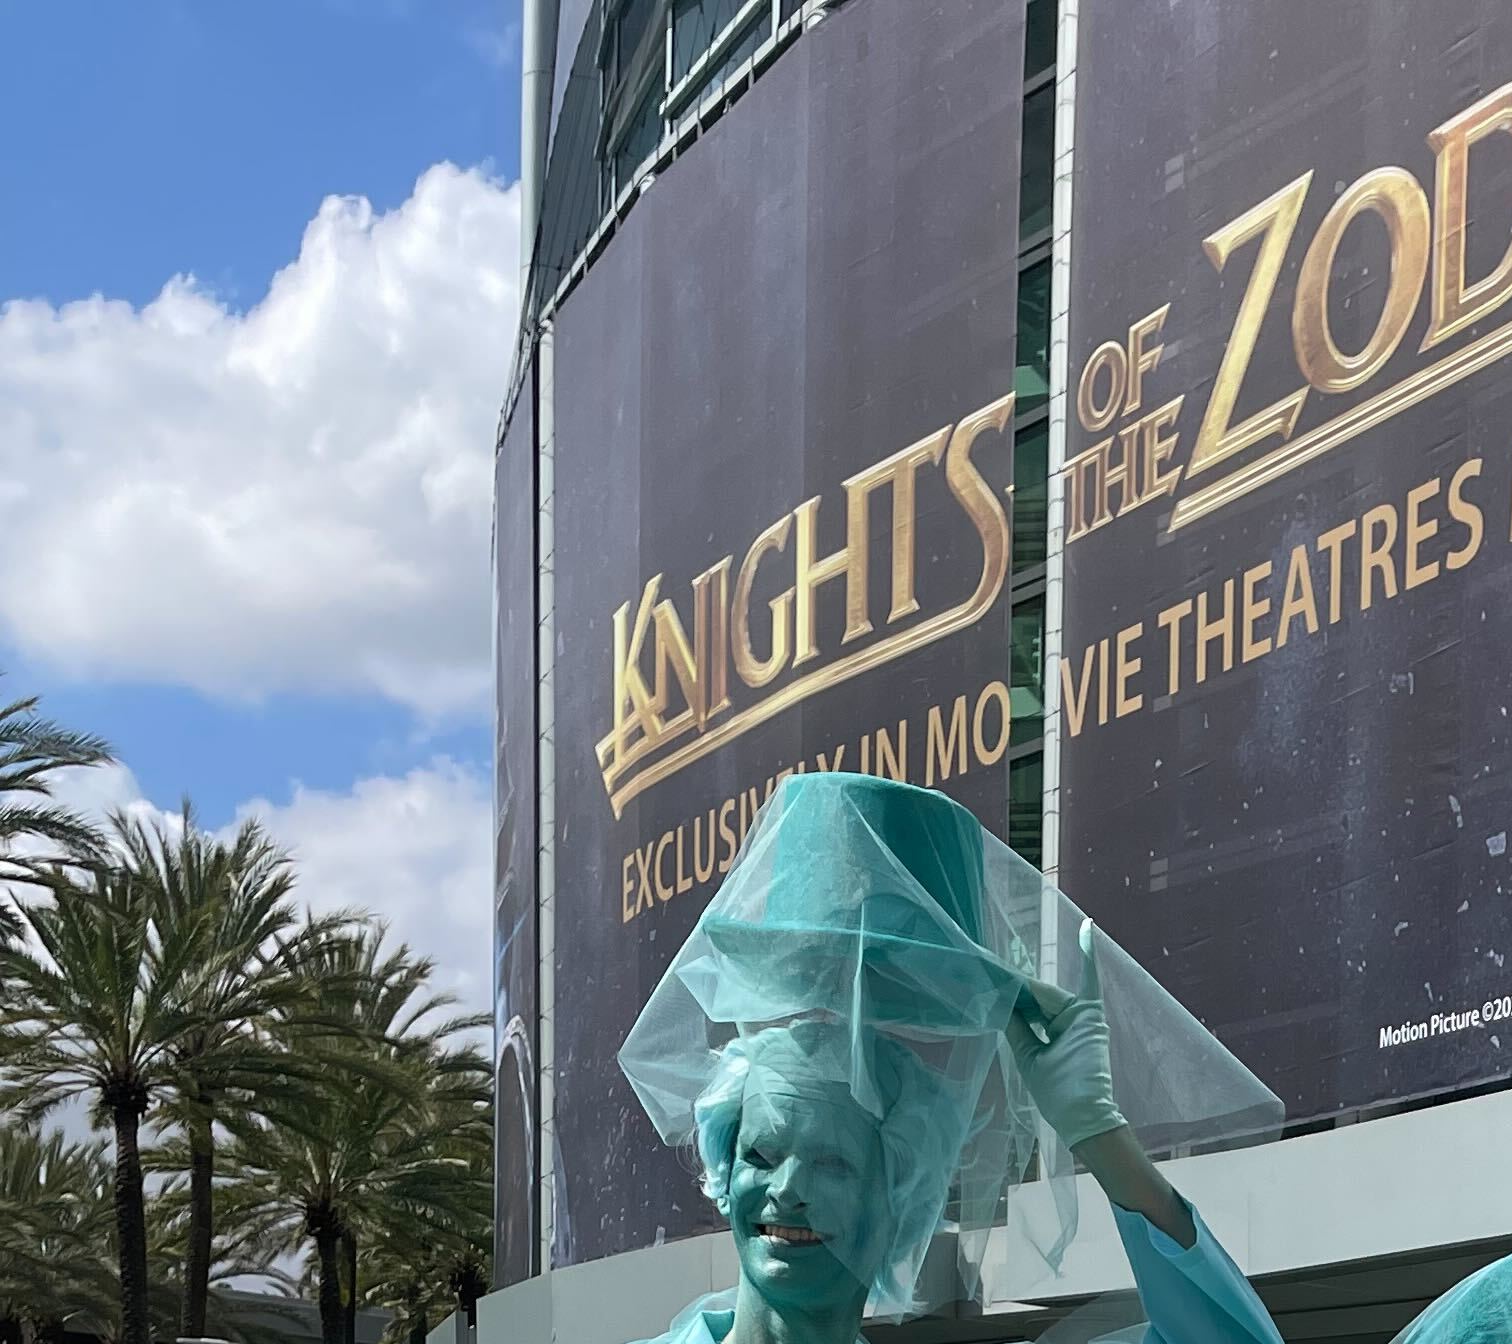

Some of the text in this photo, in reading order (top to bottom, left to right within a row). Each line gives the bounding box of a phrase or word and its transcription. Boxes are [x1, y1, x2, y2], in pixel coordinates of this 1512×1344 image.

[1077, 302, 1171, 432] OF
[1063, 394, 1184, 544] THE
[594, 391, 1016, 808] KNIGHTS
[925, 680, 1011, 787] MO
[1060, 622, 1143, 738] VIE
[1157, 457, 1485, 696] THEATRES
[1379, 1021, 1428, 1049] Motion
[1430, 1008, 1480, 1036] Picture
